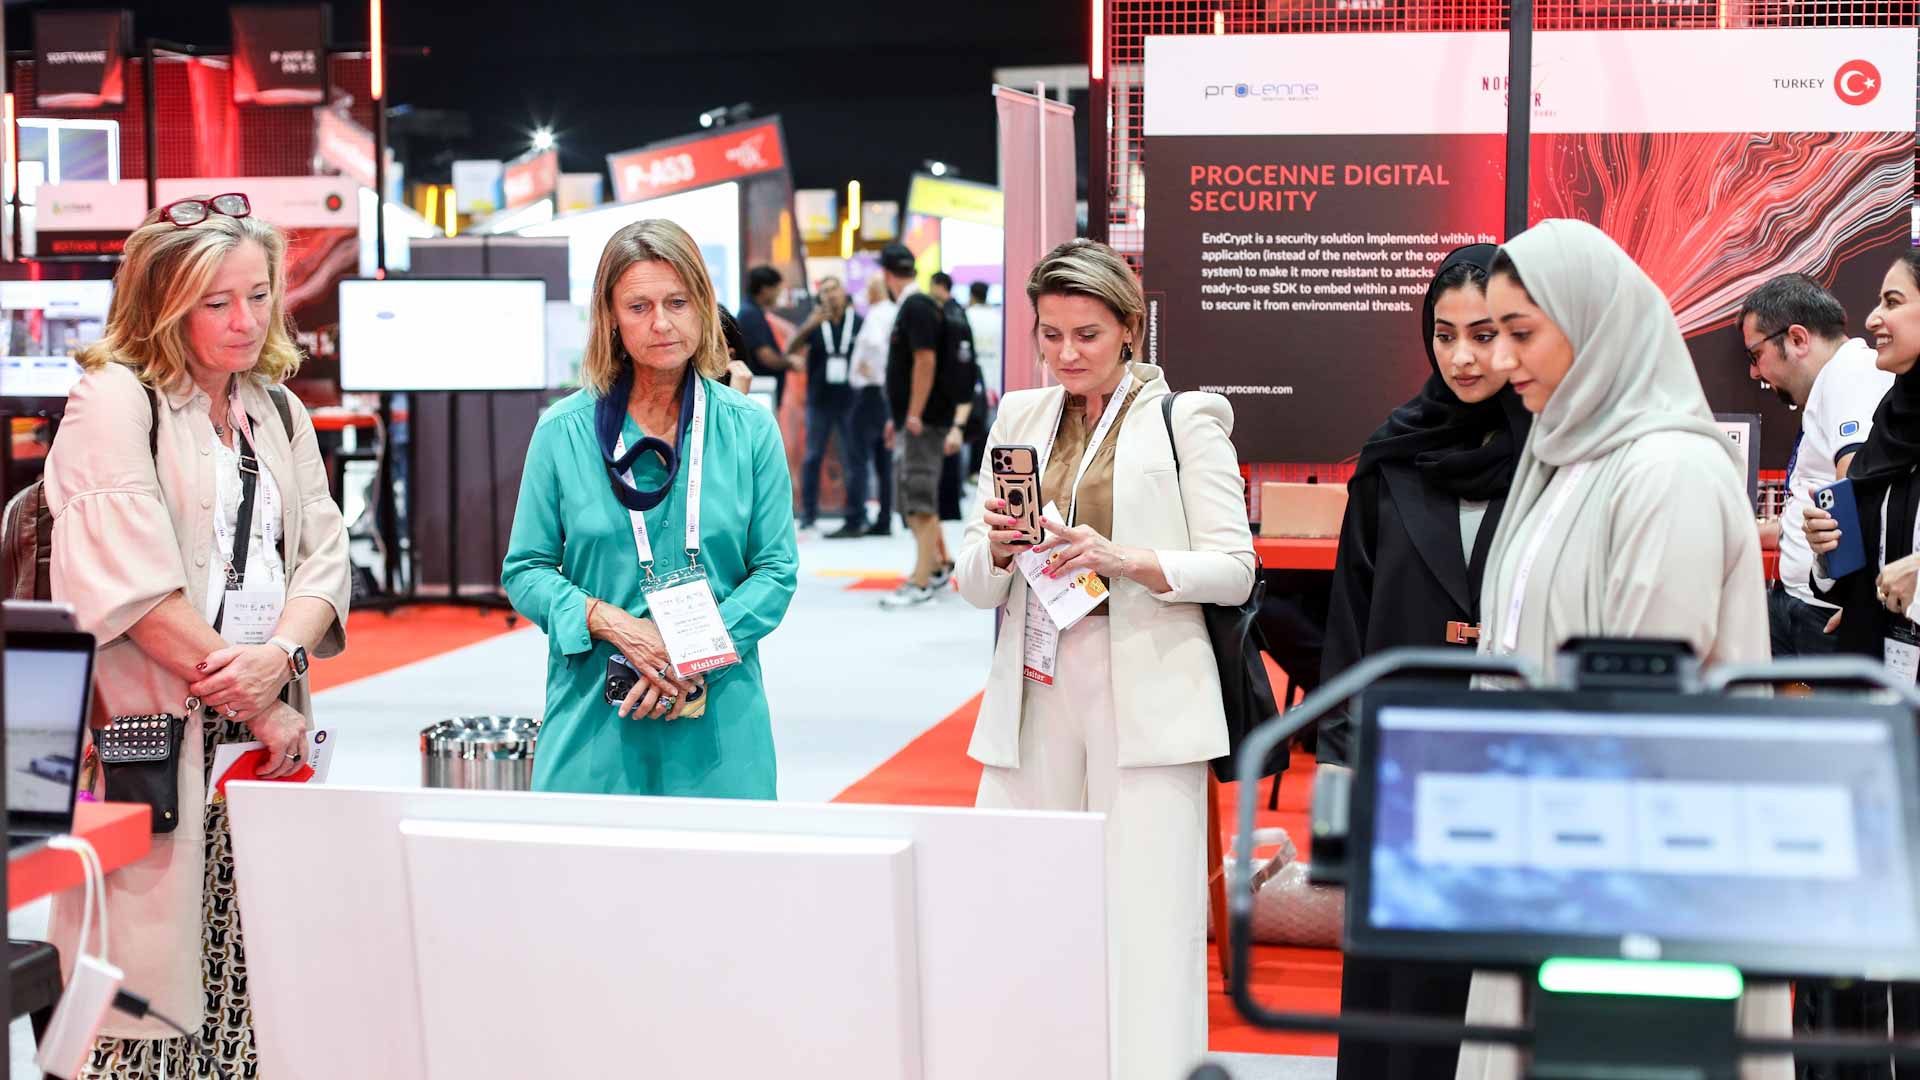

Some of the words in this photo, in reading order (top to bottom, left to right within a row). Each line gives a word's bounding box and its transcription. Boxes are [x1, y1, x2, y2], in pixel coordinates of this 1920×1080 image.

[1772, 78, 1825, 89] TURKEY
[1190, 165, 1336, 186] PROCENNE
[1344, 164, 1449, 186] DIGITAL
[1189, 191, 1317, 211] SECURITY
[1203, 233, 1253, 245] EndCrypt
[1255, 233, 1264, 244] is
[1266, 235, 1273, 243] a
[1275, 233, 1318, 245] security
[1320, 233, 1364, 244] solution
[1367, 233, 1438, 246] implemented
[1440, 233, 1475, 244] within
[1478, 233, 1496, 244] the
[1202, 249, 1261, 262] application
[1263, 249, 1305, 261] (instead
[1308, 249, 1320, 260] of
[1322, 249, 1340, 260] the
[1343, 249, 1388, 261] network
[1391, 252, 1403, 261] or
[1405, 250, 1423, 261] the
[1202, 266, 1243, 278] system)
[1245, 267, 1257, 277] to
[1259, 266, 1288, 277] make
[1291, 266, 1298, 277] it
[1301, 269, 1329, 277] more
[1332, 266, 1378, 277] resistant
[1381, 267, 1393, 277] to
[1395, 267, 1435, 278] attacks.
[1202, 283, 1270, 295] ready-to-use
[1273, 283, 1297, 294] SDK
[1300, 284, 1311, 294] to
[1314, 283, 1351, 294] embed
[1353, 283, 1387, 294] within
[1390, 286, 1396, 294] a
[1202, 301, 1213, 310] to
[1216, 302, 1251, 310] secure
[1253, 299, 1261, 310] it
[1264, 299, 1289, 310] from
[1292, 300, 1369, 311] environmental
[1372, 300, 1413, 311] threats.
[1149, 300, 1158, 365] OOTSTRAPPING
[1199, 385, 1293, 396] www.procenne.com
[690, 656, 725, 671] Visitor
